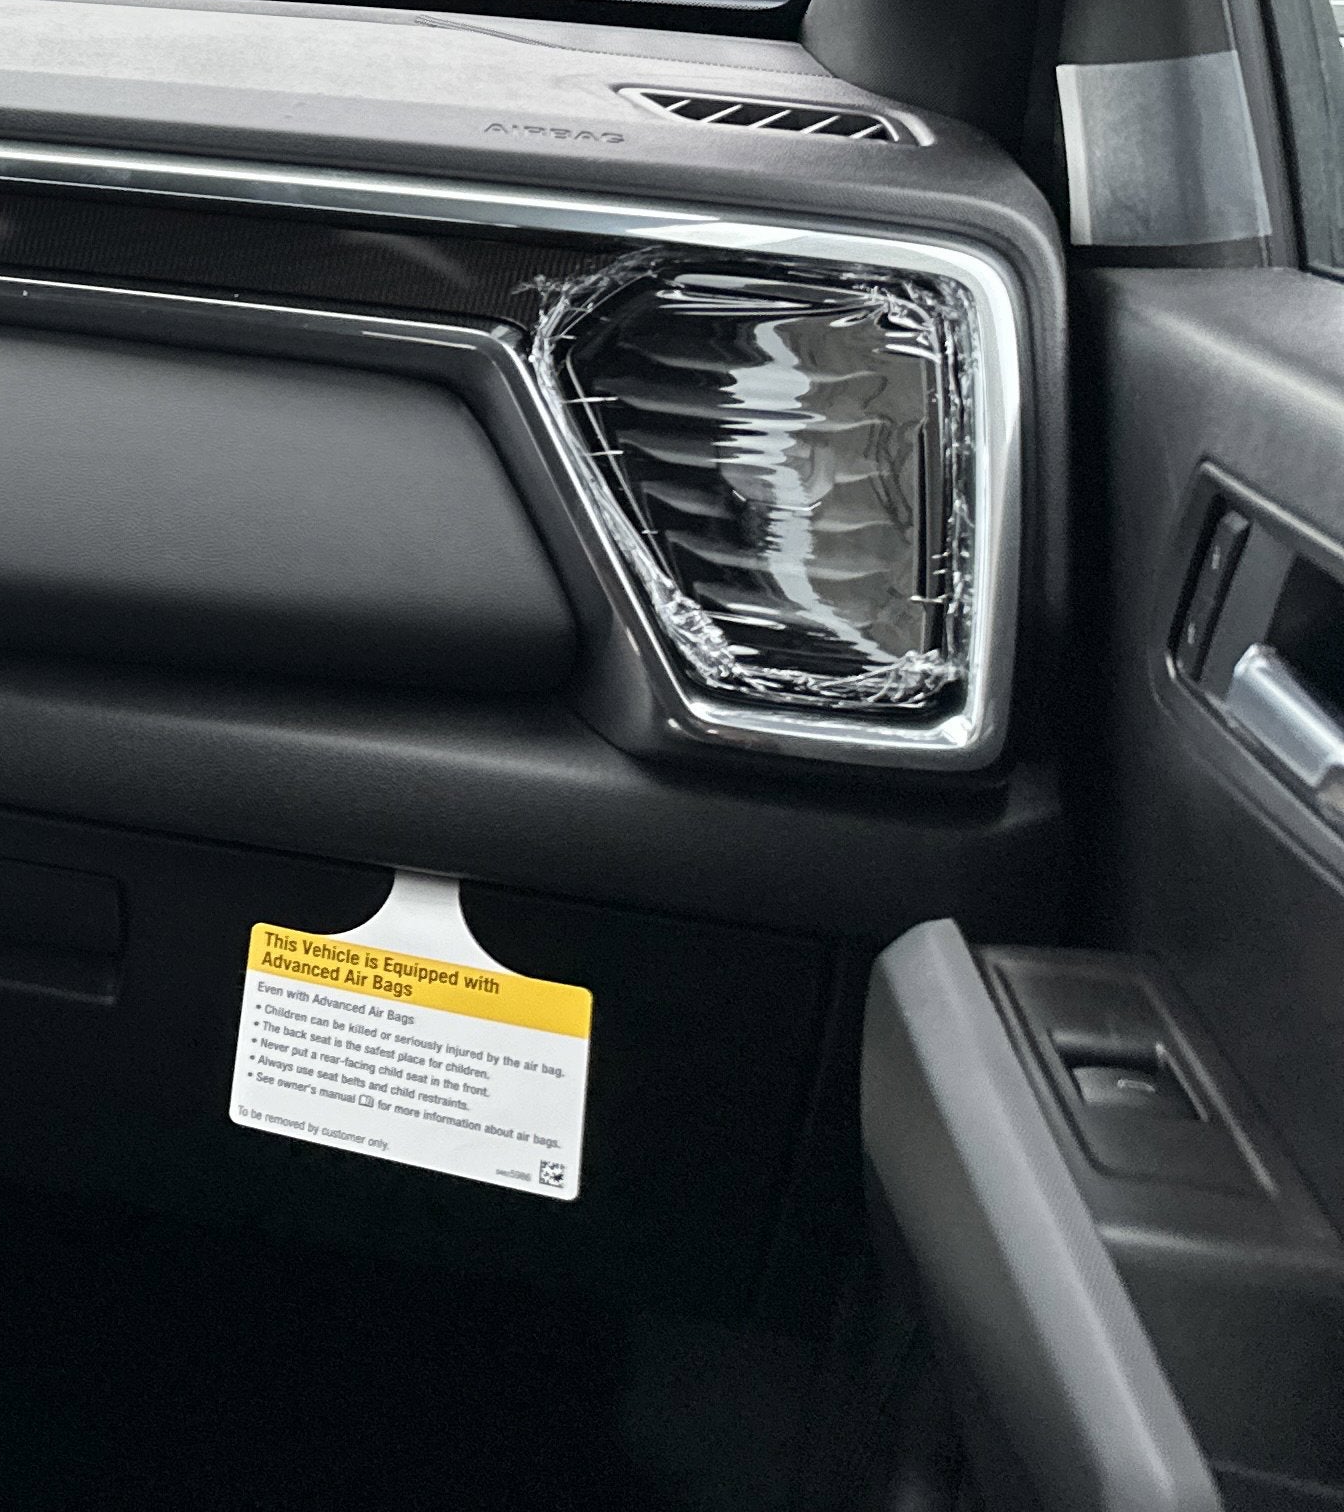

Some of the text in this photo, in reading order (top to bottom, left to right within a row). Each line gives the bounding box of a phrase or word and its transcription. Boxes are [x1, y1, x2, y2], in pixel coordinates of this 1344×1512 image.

[261, 951, 413, 998] Advanced Air Bags
[264, 931, 500, 994] This Vehicle is Equipped with
[257, 981, 415, 1025] Even with Advanced Air Bags
[260, 1038, 490, 1098] Never put a rear-facing child seat in the front.
[263, 1021, 490, 1080] The back seat is the safest place for children.
[264, 1004, 565, 1078] Children can be killed or seriously injured by the air bag.
[256, 1072, 560, 1149] See owner's manual for more information about air bags.
[257, 1055, 470, 1110] Always use seat belts and child restraints.
[238, 1104, 389, 1152] To be removed by customer only.
